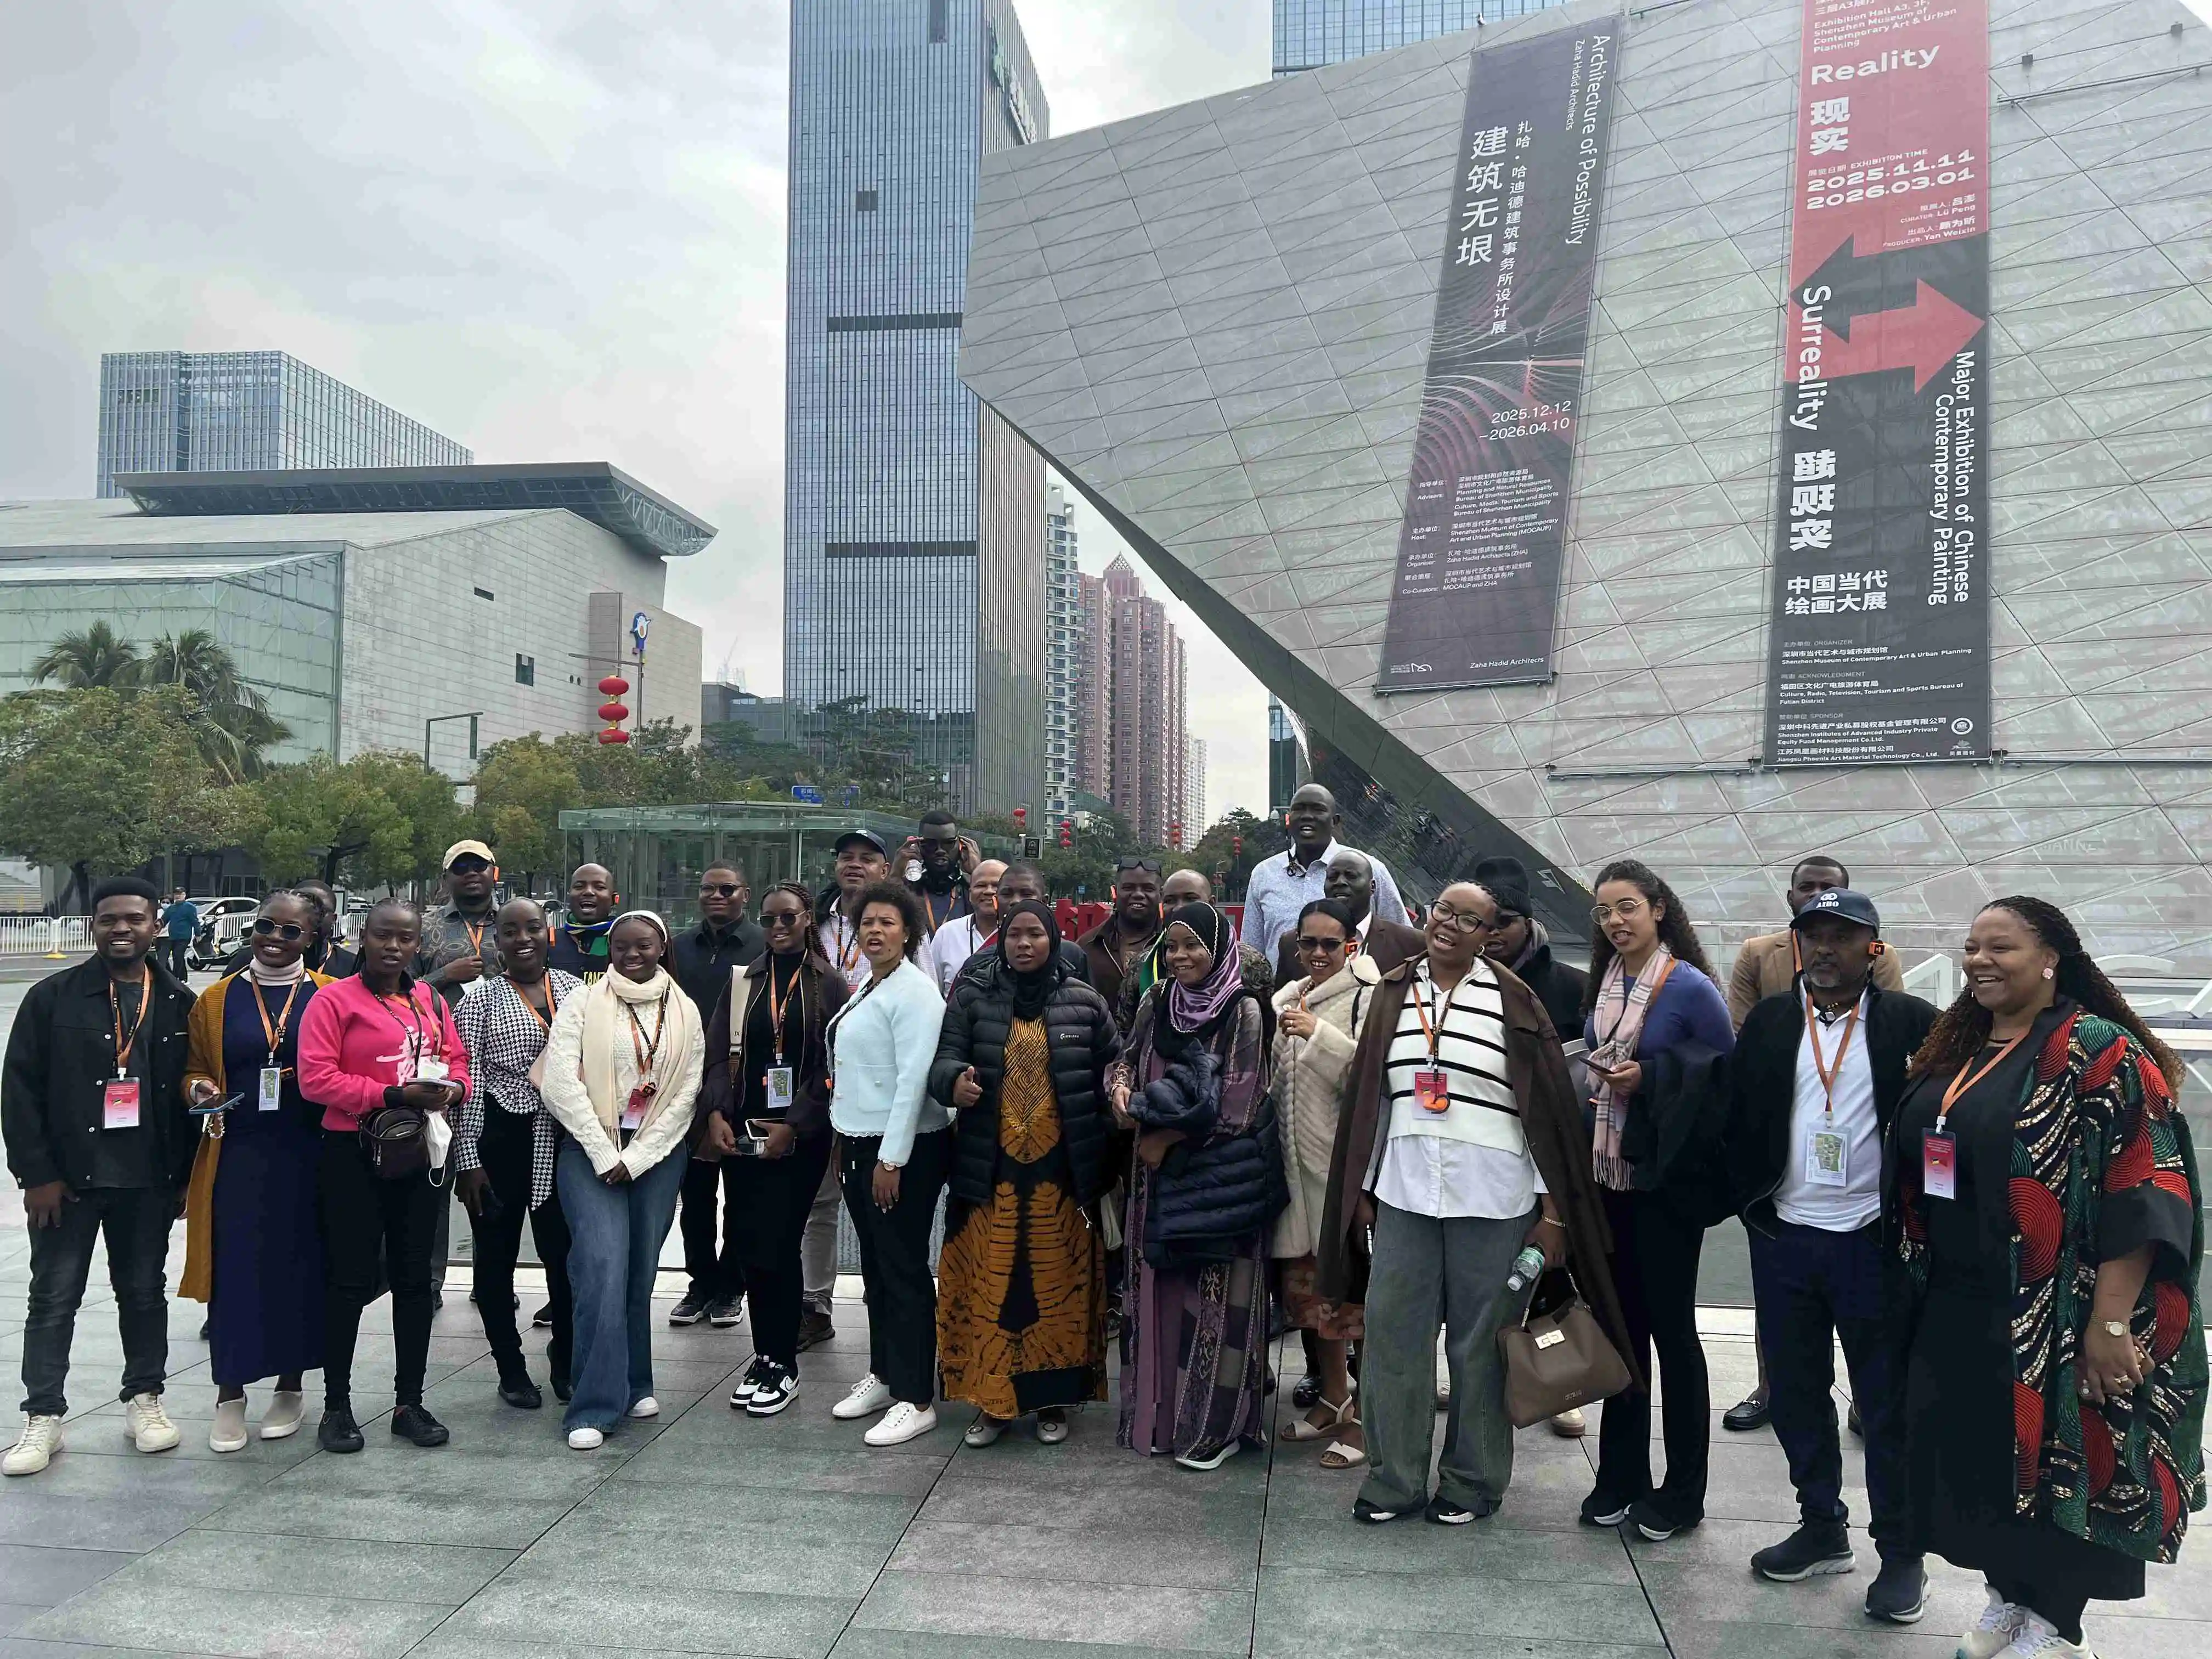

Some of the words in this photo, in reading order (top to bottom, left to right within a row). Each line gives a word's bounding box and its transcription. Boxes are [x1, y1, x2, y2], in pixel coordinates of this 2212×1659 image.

[1814, 13, 1866, 29] Exhibition
[1869, 8, 1891, 17] Hall
[1814, 21, 1865, 37] Shenzhen
[1868, 12, 1914, 25] Museum
[1814, 25, 1889, 45] Contemporary
[1893, 20, 1909, 29] Art
[1923, 8, 1957, 22] Urban
[1573, 39, 1585, 61] Zaha
[1814, 40, 1860, 53] Planning
[1571, 61, 1583, 87] Hadid
[1811, 45, 1940, 85] Reality
[1582, 36, 1611, 134] Architecture
[1566, 89, 1579, 131] Architects
[1809, 96, 1850, 156] 现实
[1581, 138, 1595, 154] of
[1808, 149, 1975, 192] 2025.11.11
[1850, 154, 1903, 169] EXHIBITION
[1905, 149, 1928, 158] TIME
[1455, 125, 1509, 267] 建筑无垠
[1807, 167, 1975, 210] 2026.03.01
[1565, 159, 1597, 245] Possibility
[1952, 205, 1976, 215] Peng
[1943, 227, 1976, 237] Weixin
[1790, 285, 1832, 431] Surreality
[1951, 351, 1975, 401] Major
[1491, 400, 1571, 424] 2025.12.12
[1929, 393, 1954, 521] Contemporary
[1955, 406, 1974, 498] Exhibition
[1457, 487, 1482, 495] Planning
[1519, 478, 1551, 488] Resources
[1485, 490, 1514, 499] Shenzhen
[1515, 484, 1553, 495] Municipality
[1483, 505, 1513, 514] Shenzhen
[1514, 499, 1551, 510] Municipality
[1955, 504, 1974, 523] of
[1491, 531, 1518, 539] Planning
[1516, 518, 1559, 529] Contemporary
[1481, 552, 1510, 560] Architects
[1928, 527, 1953, 606] Painting
[1954, 530, 1974, 603] Chinese
[1786, 569, 1888, 595] 中国当代
[1785, 591, 1888, 616] 绘画大展
[1510, 657, 1544, 665] Architects
[1850, 654, 1897, 663] Contemporary
[583, 972, 606, 986] TAN
